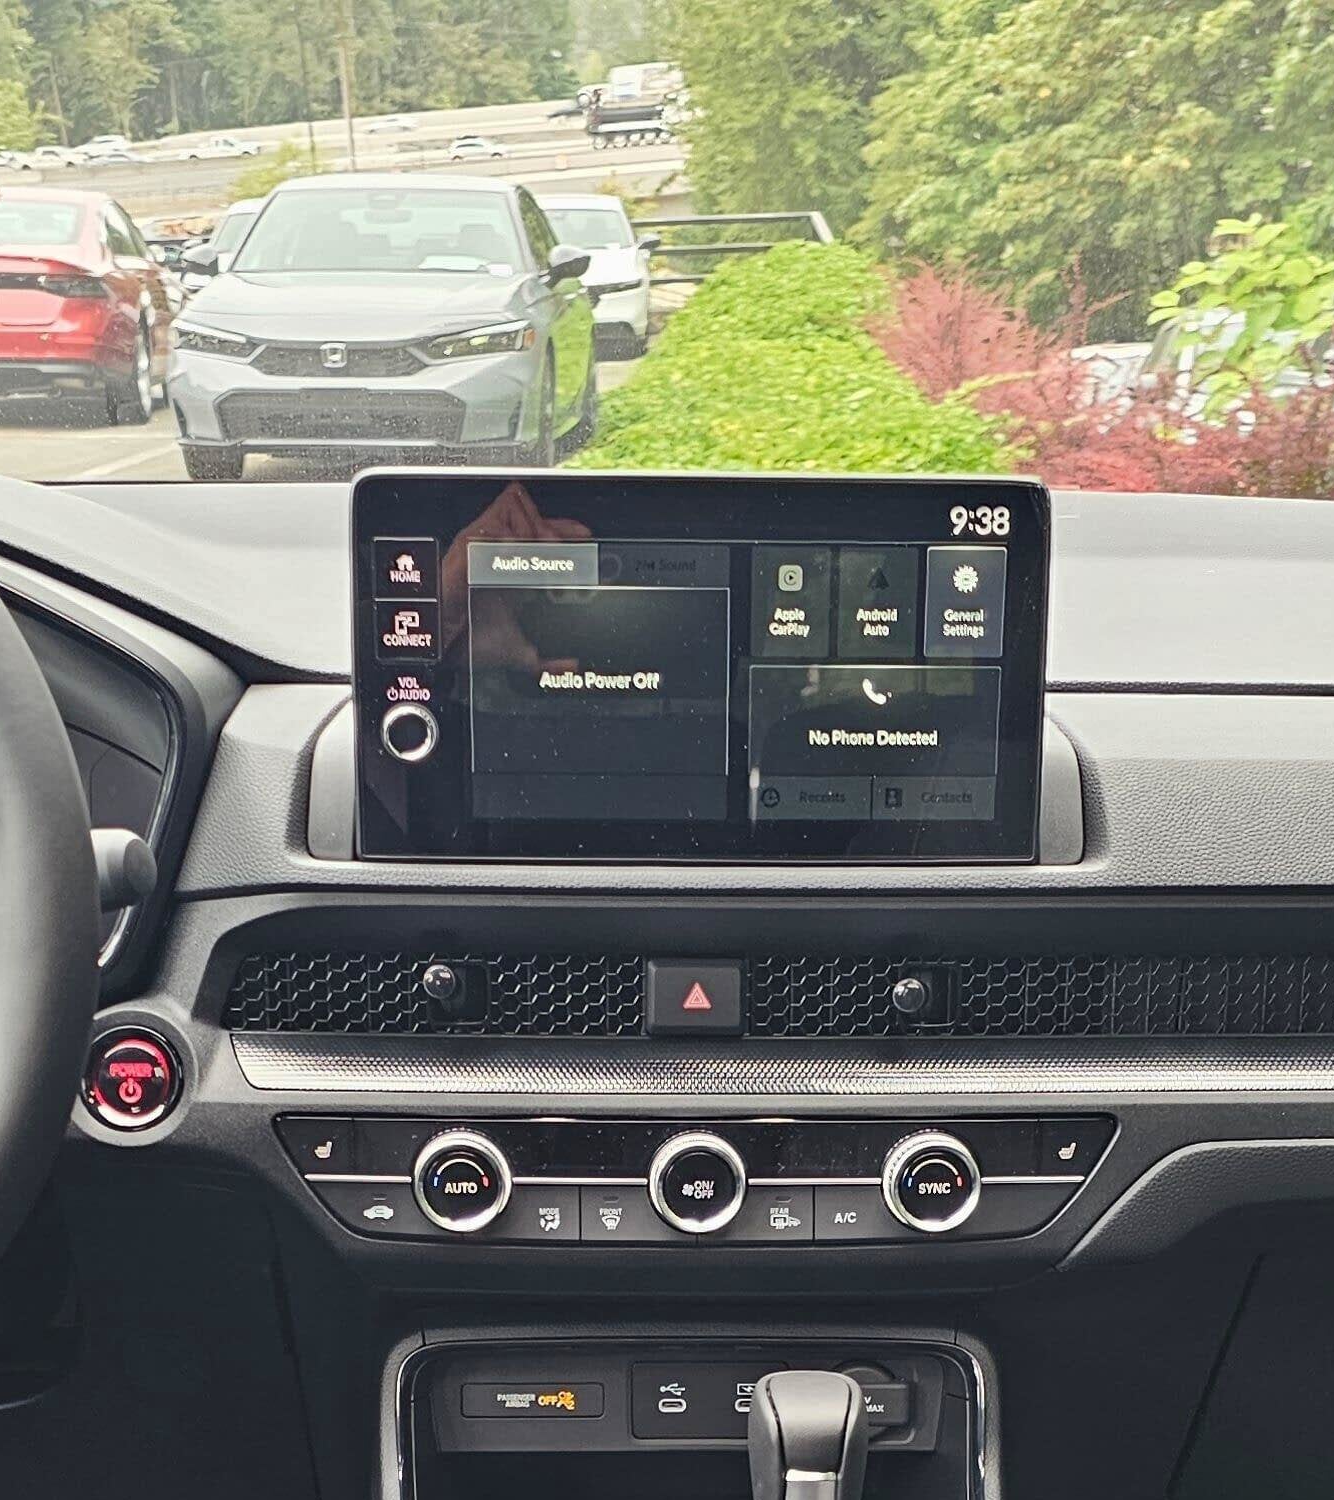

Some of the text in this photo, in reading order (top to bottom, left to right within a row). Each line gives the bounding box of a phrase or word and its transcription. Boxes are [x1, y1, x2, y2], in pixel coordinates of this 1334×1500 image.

[949, 505, 1011, 536] 9:38
[491, 557, 574, 572] Audio Source
[390, 570, 421, 583] HOME
[774, 608, 805, 623] Apple
[856, 608, 898, 622] Android
[943, 609, 985, 622] General
[769, 622, 810, 638] CarPlay
[863, 623, 890, 637] Auto
[942, 623, 985, 639] Settings
[382, 633, 432, 647] CONNECT
[397, 676, 420, 689] VOL
[539, 671, 660, 690] Audio Power Off
[398, 688, 431, 701] AUDIO
[808, 729, 939, 747] No Phone Detected
[444, 1182, 478, 1195] AUTO
[693, 1180, 715, 1190] ON/
[918, 1182, 951, 1195] SYNC
[693, 1189, 715, 1200] OFF
[538, 1207, 560, 1216] MODE
[599, 1207, 623, 1216] FRONT
[770, 1207, 789, 1216] REAR
[834, 1212, 857, 1225] A/C
[537, 1395, 559, 1406] OFF
